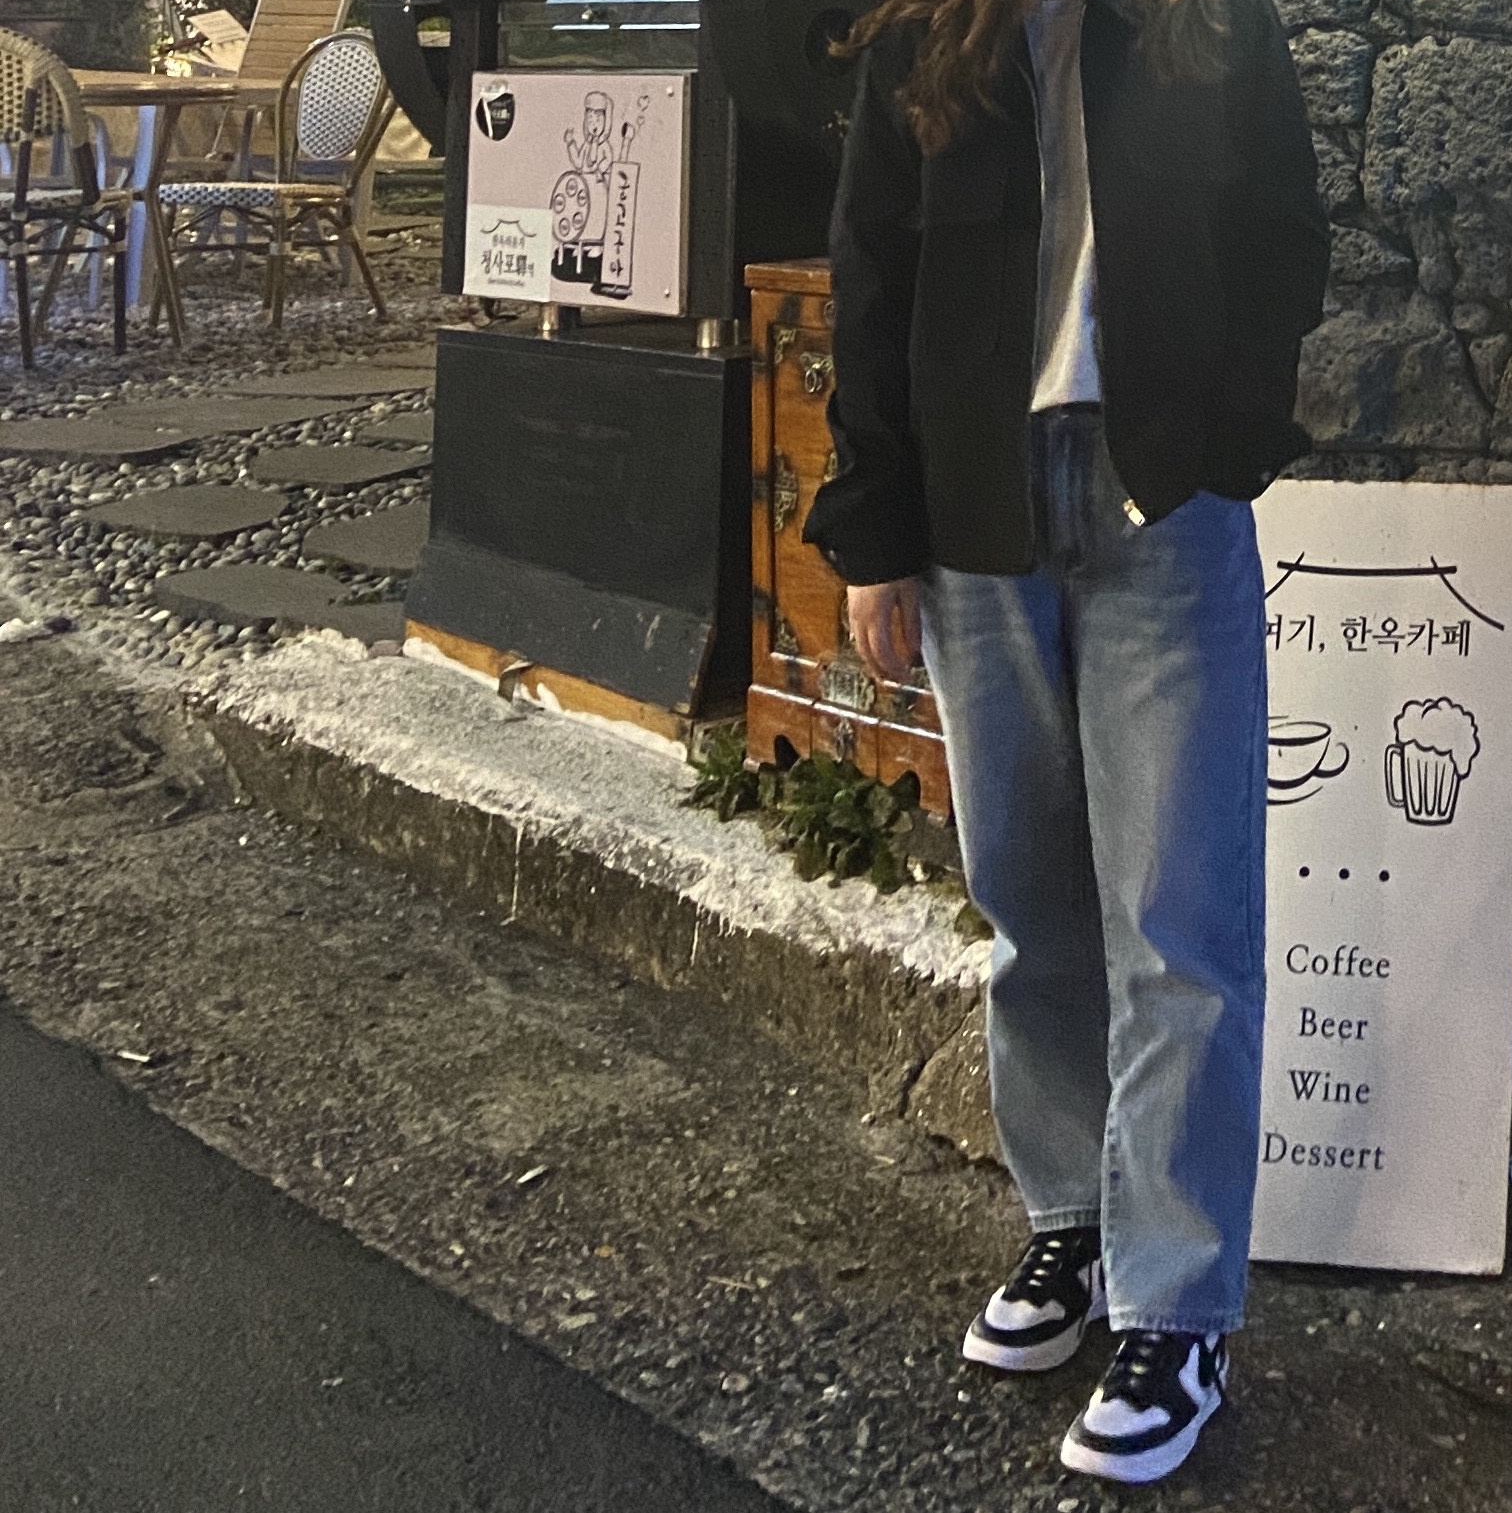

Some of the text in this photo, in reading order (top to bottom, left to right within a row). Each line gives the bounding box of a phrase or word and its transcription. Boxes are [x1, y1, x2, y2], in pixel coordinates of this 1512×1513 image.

[1341, 616, 1470, 656] 한옥카페
[1286, 944, 1390, 978] Coffee
[1298, 1007, 1368, 1040] Beer
[1288, 1070, 1371, 1104] Wine
[1262, 1131, 1384, 1170] Dessert
